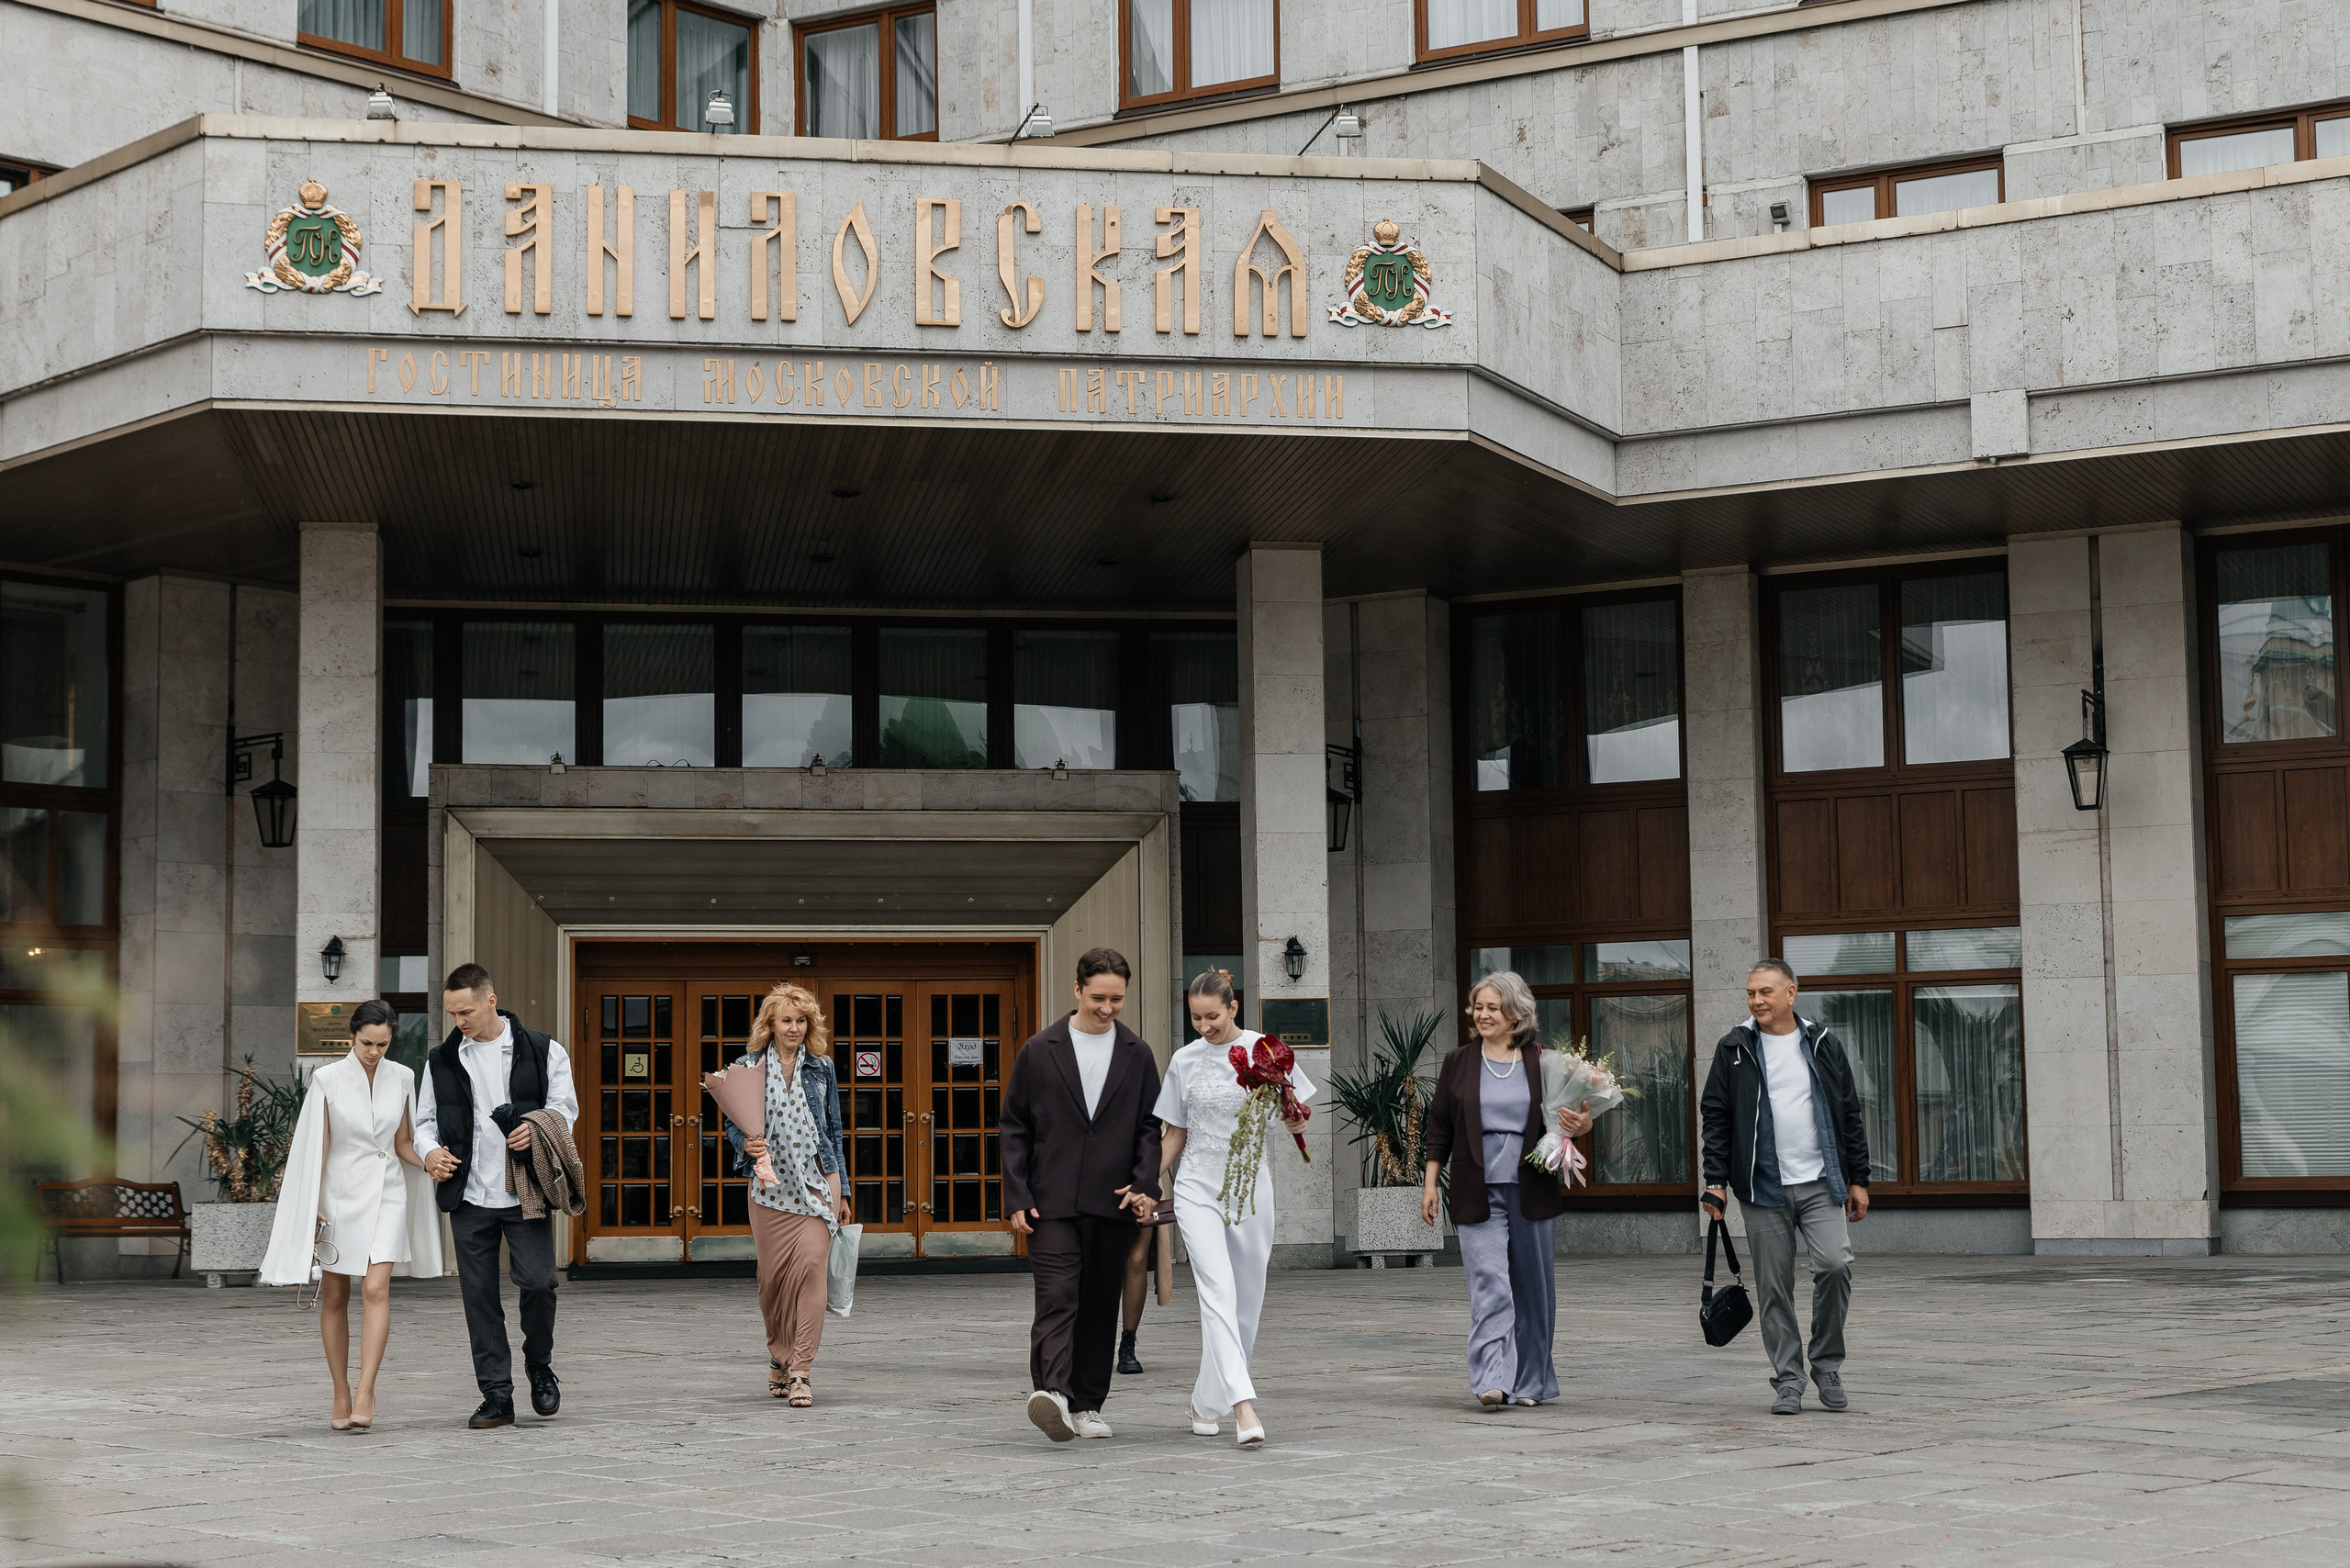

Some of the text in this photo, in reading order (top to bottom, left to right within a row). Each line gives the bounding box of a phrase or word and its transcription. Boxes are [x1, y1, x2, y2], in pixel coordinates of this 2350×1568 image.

[368, 348, 1344, 419] ГОСТИНИЦА МОСКОВСКОЙ ПАТРИАРХИИ
[957, 1042, 977, 1051] Вход
